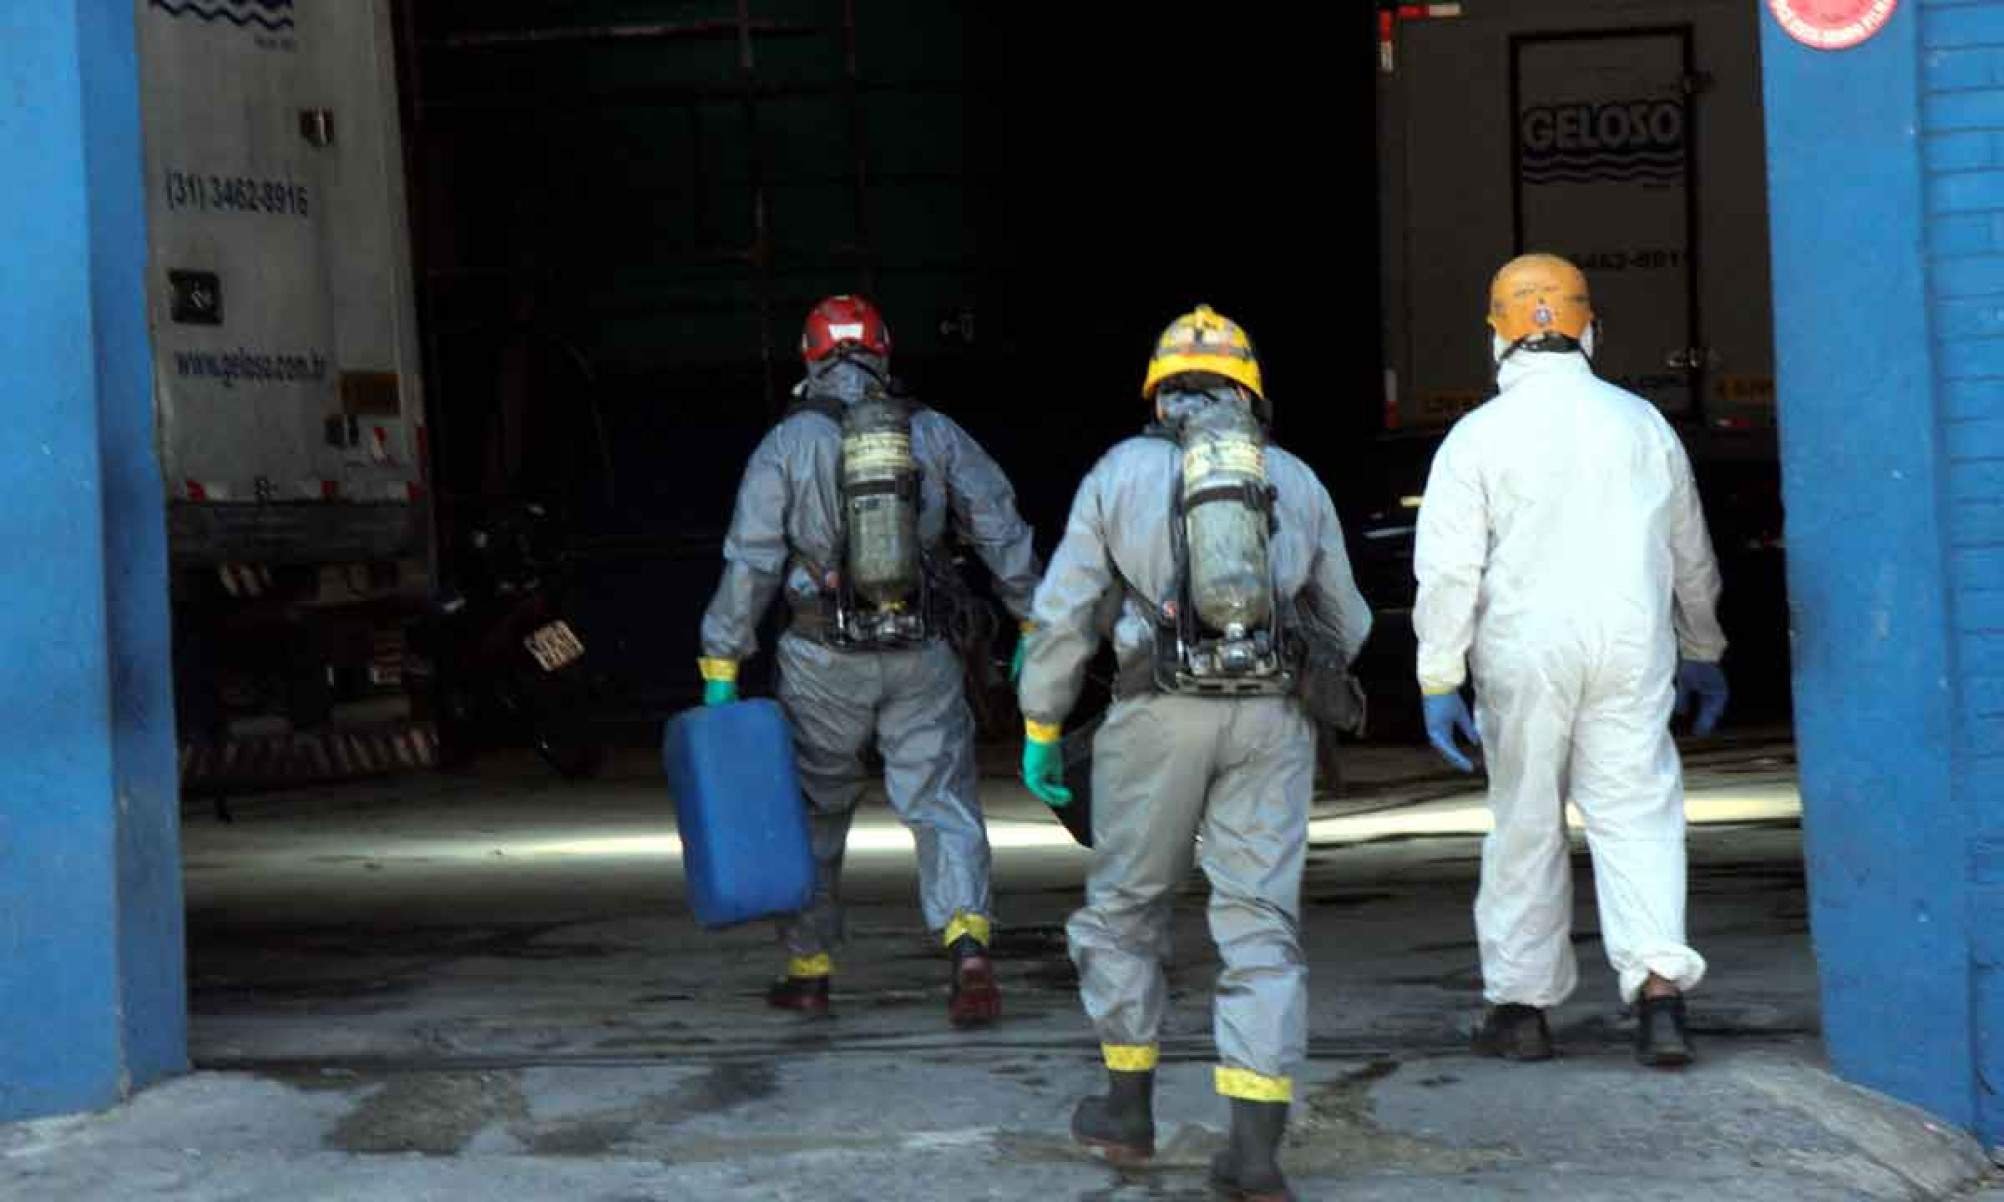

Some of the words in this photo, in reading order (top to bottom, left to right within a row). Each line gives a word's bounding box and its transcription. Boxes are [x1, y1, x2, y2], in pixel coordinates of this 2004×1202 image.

[1521, 100, 1684, 150] GELOSO
[168, 170, 205, 210] (31)
[176, 349, 325, 386] www.geloso.com.br
